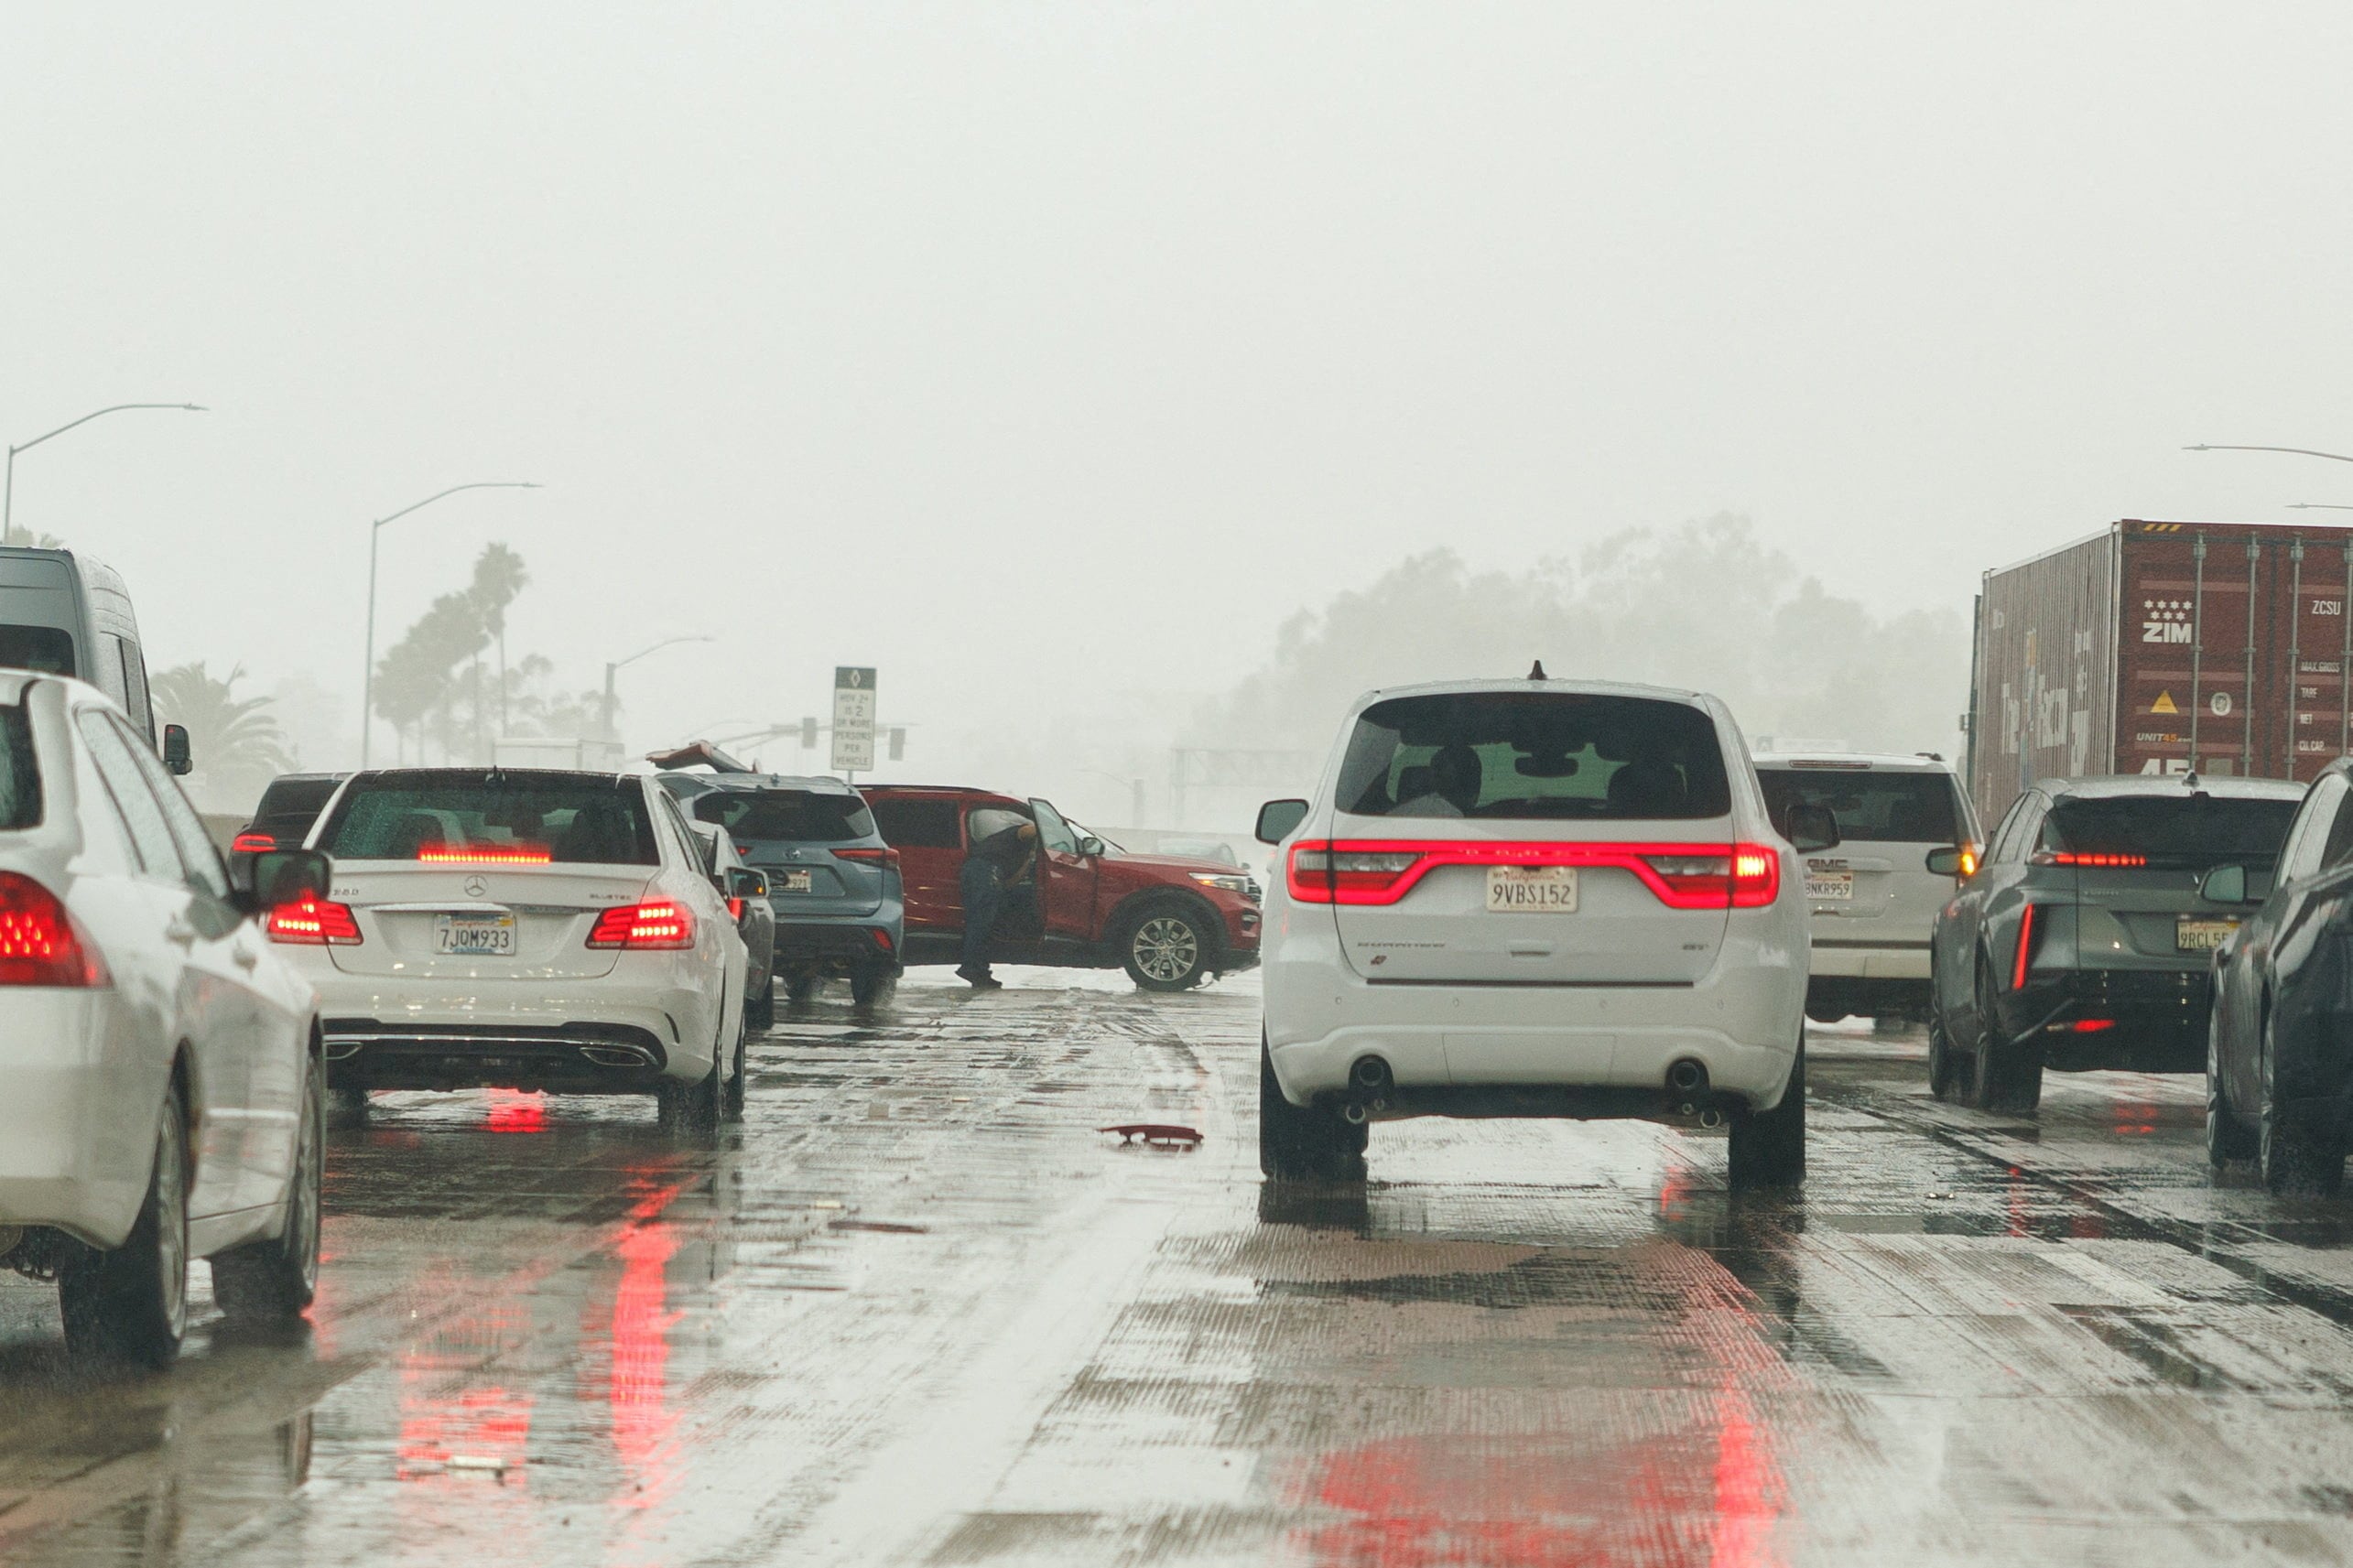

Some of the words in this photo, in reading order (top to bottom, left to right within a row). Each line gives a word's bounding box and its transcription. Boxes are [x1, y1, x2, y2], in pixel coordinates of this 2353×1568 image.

[2312, 600, 2341, 615] ZCSU
[2143, 622, 2192, 643] ZIM
[855, 705, 863, 717] 2
[835, 731, 872, 741] PERSONS
[844, 744, 861, 752] PER
[836, 756, 869, 765] VEHICLE
[1807, 859, 1849, 869] GMC
[1493, 883, 1571, 904] 9VBS152
